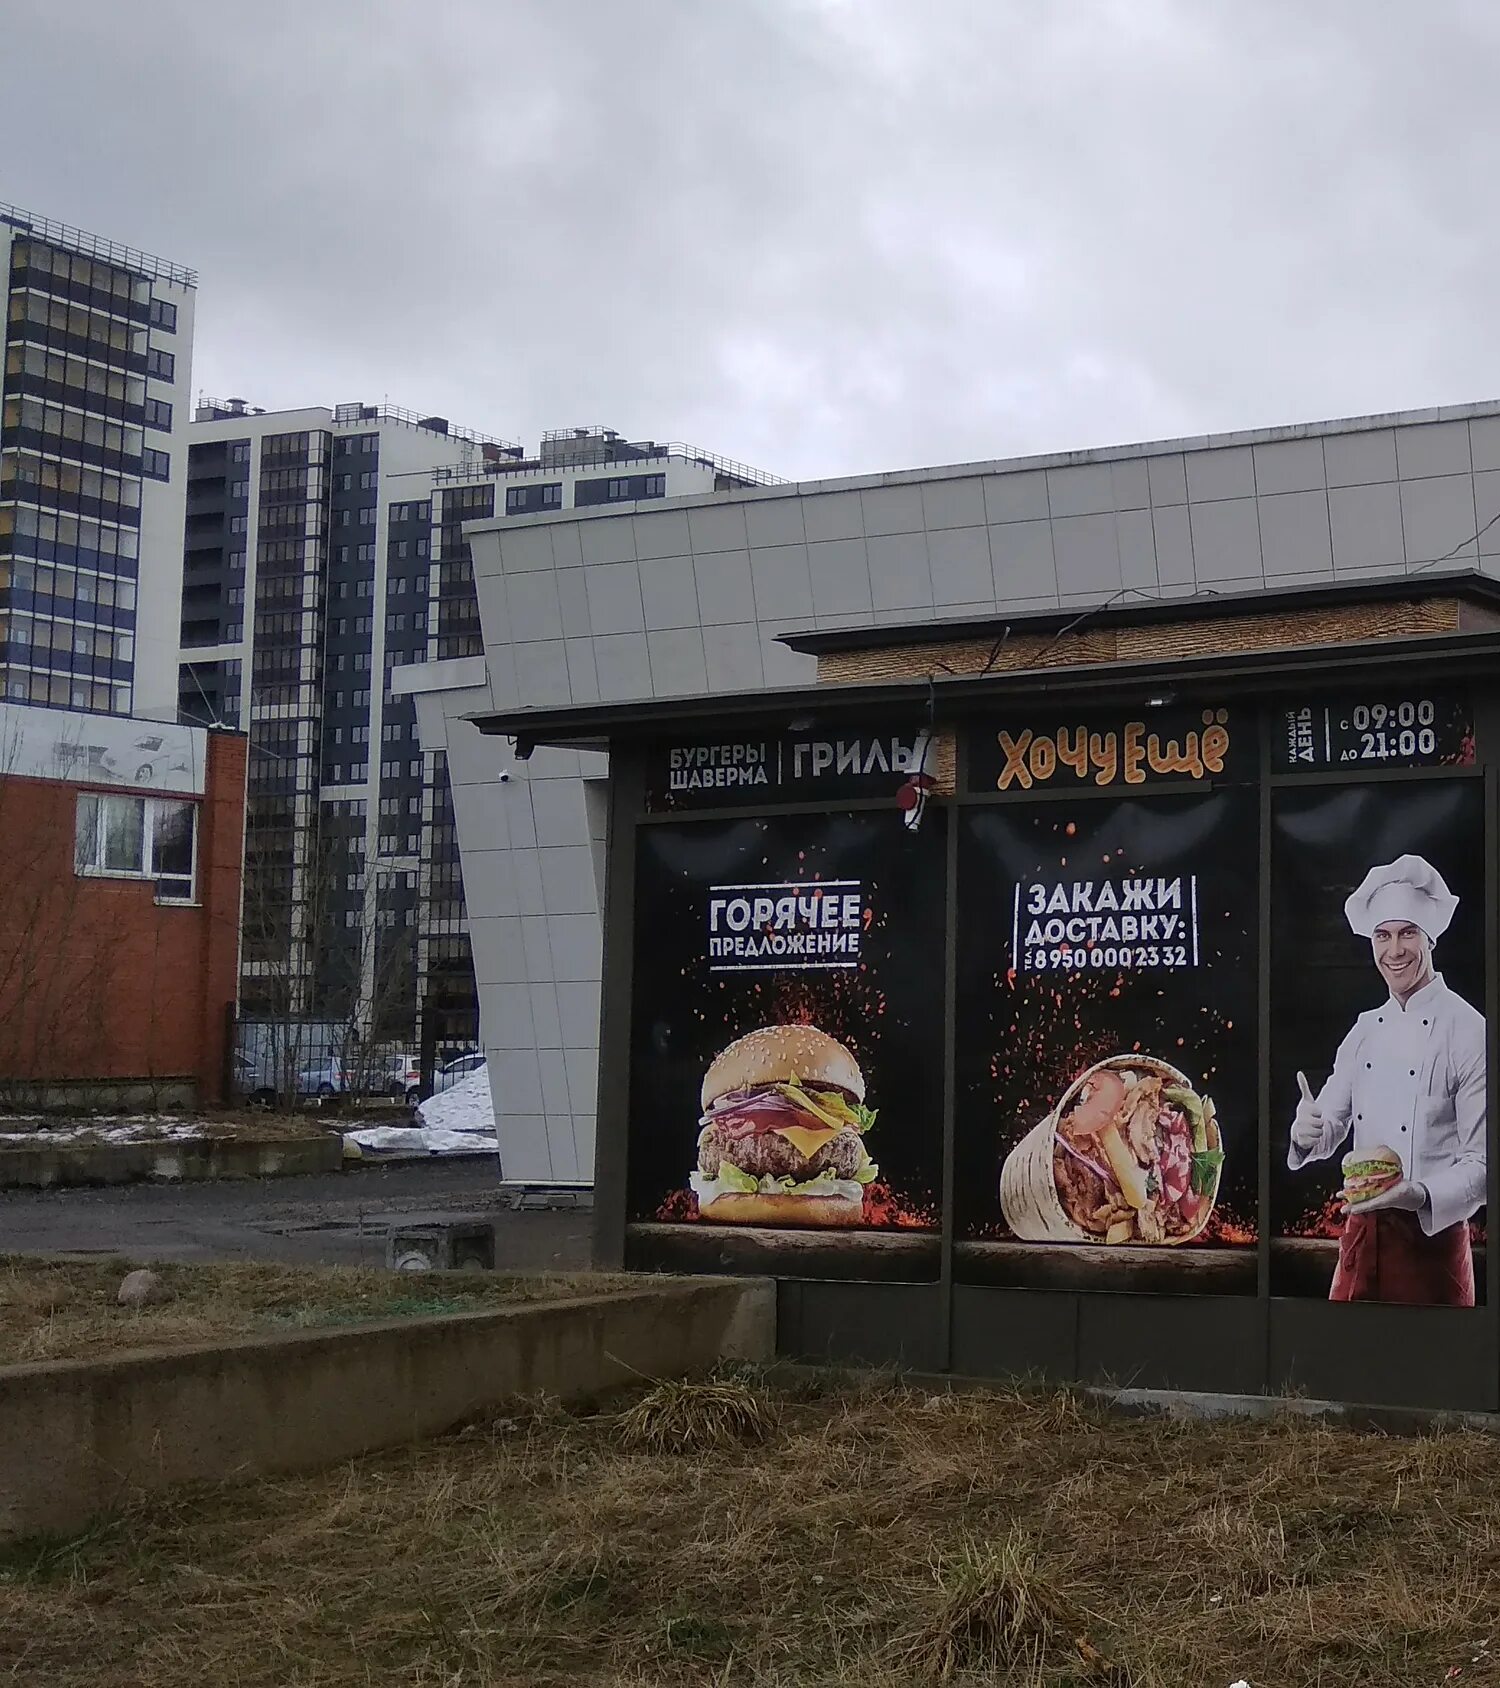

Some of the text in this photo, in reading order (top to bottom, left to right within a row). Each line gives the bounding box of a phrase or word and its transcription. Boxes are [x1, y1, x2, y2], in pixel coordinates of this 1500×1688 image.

[1353, 700, 1434, 731] 09:00
[1286, 711, 1297, 763] КАЖДЫЙ
[1298, 707, 1315, 762] ДЕНЬ
[1360, 728, 1435, 759] 21:00
[670, 743, 765, 768] БУРГЕРЫ
[794, 737, 914, 779] ГРИЛЬ
[670, 765, 768, 789] ШАВЕРМА
[1027, 877, 1181, 915] ЗАКАЖИ
[710, 895, 860, 931] ГОРЯЧЕЕ
[709, 934, 859, 957] ПРЕДЛОЖЕНИЕ
[1024, 915, 1186, 947] ДОСТАВКУ:
